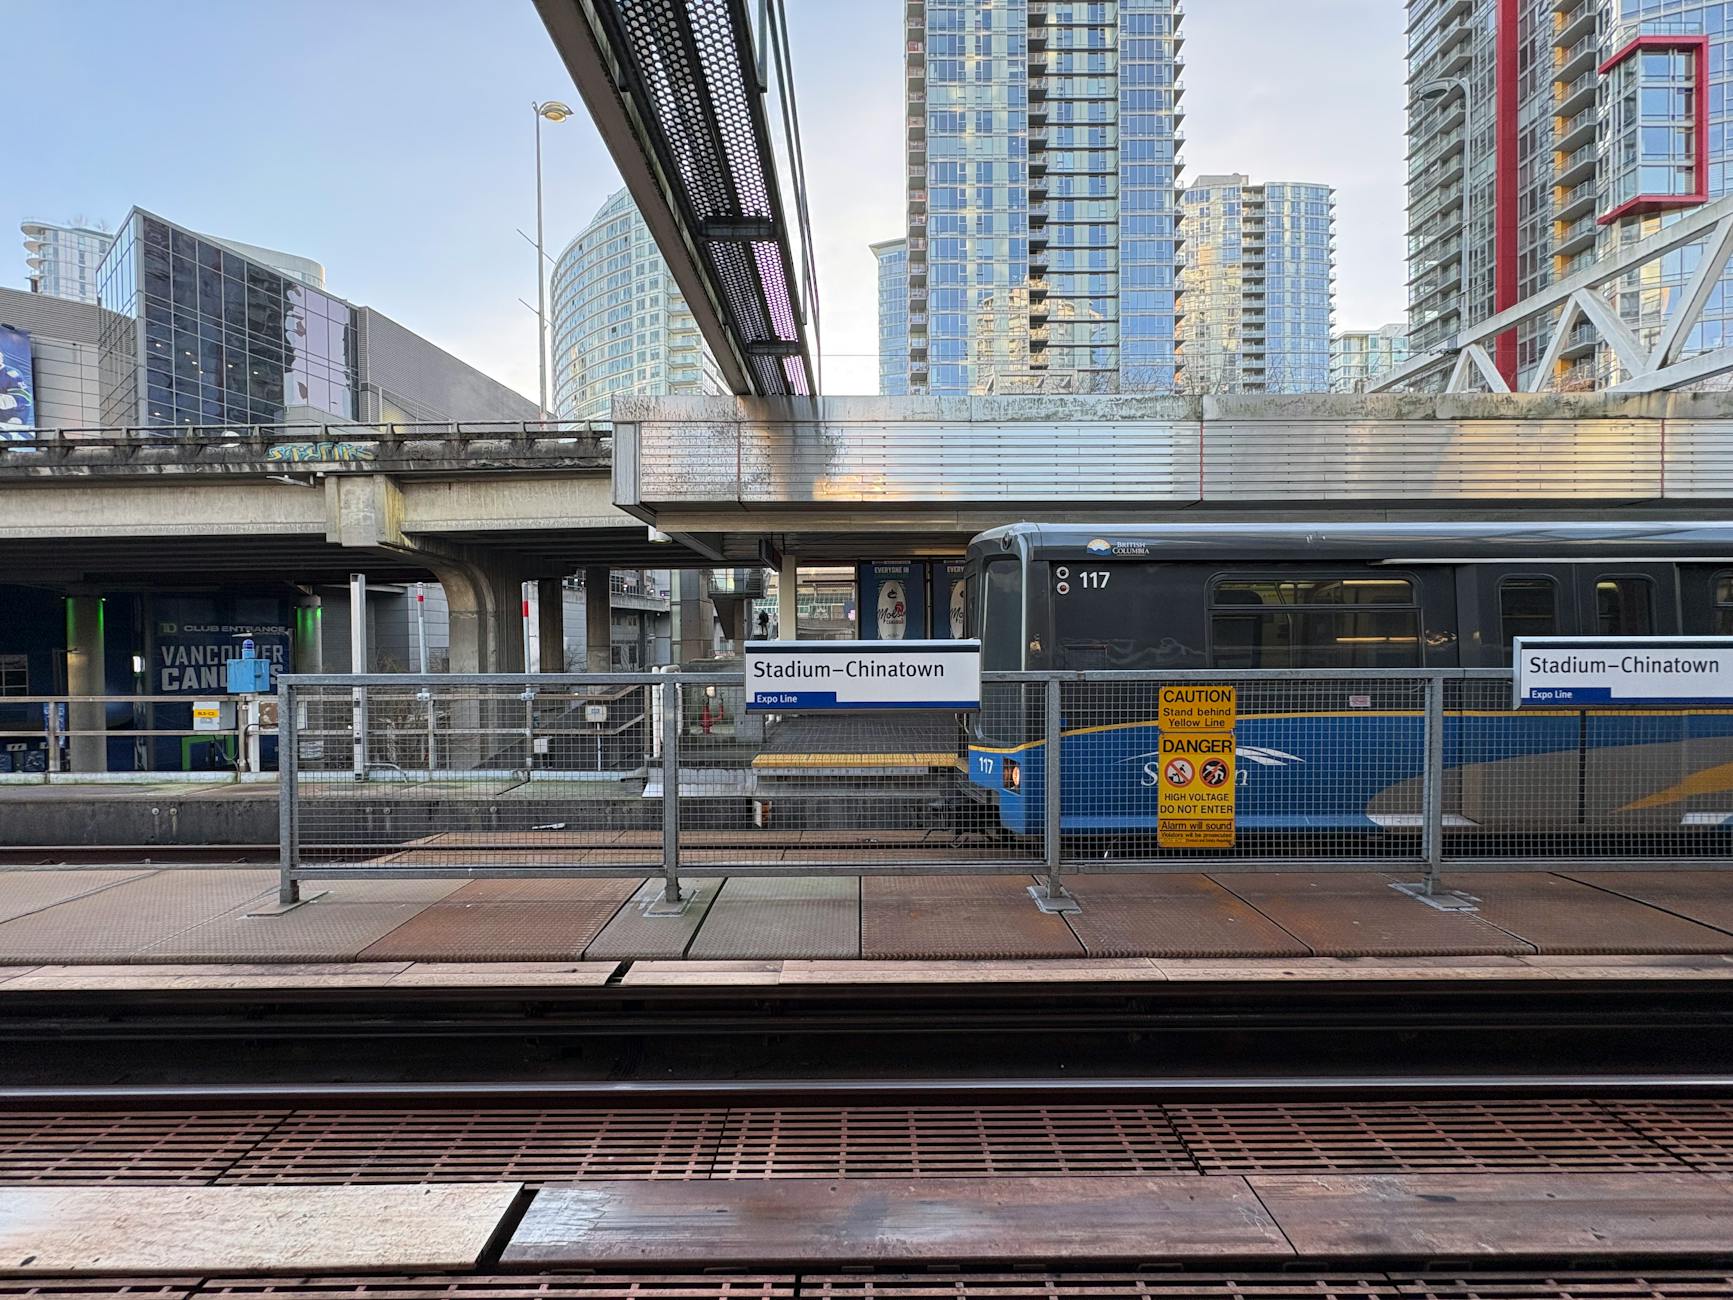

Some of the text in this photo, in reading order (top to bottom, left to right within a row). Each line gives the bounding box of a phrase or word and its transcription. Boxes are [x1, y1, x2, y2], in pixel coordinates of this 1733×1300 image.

[1112, 547, 1150, 555] COLUMBIA
[1079, 571, 1111, 589] 117
[221, 625, 286, 633] ENTRANCE
[161, 645, 283, 666] VANCOER
[756, 694, 798, 704] Expo Line
[1163, 689, 1232, 703] CAUTION
[1531, 690, 1573, 699] Expo Line
[1162, 707, 1231, 717] Stand behind
[1168, 718, 1225, 727] Yellow Line
[1162, 739, 1233, 753] DANGER
[979, 756, 994, 775] 117
[1164, 793, 1229, 801] HIGH VOLTAGE
[1160, 804, 1233, 814] DO NOT ENTER
[1161, 821, 1232, 830] Alarm will sound
